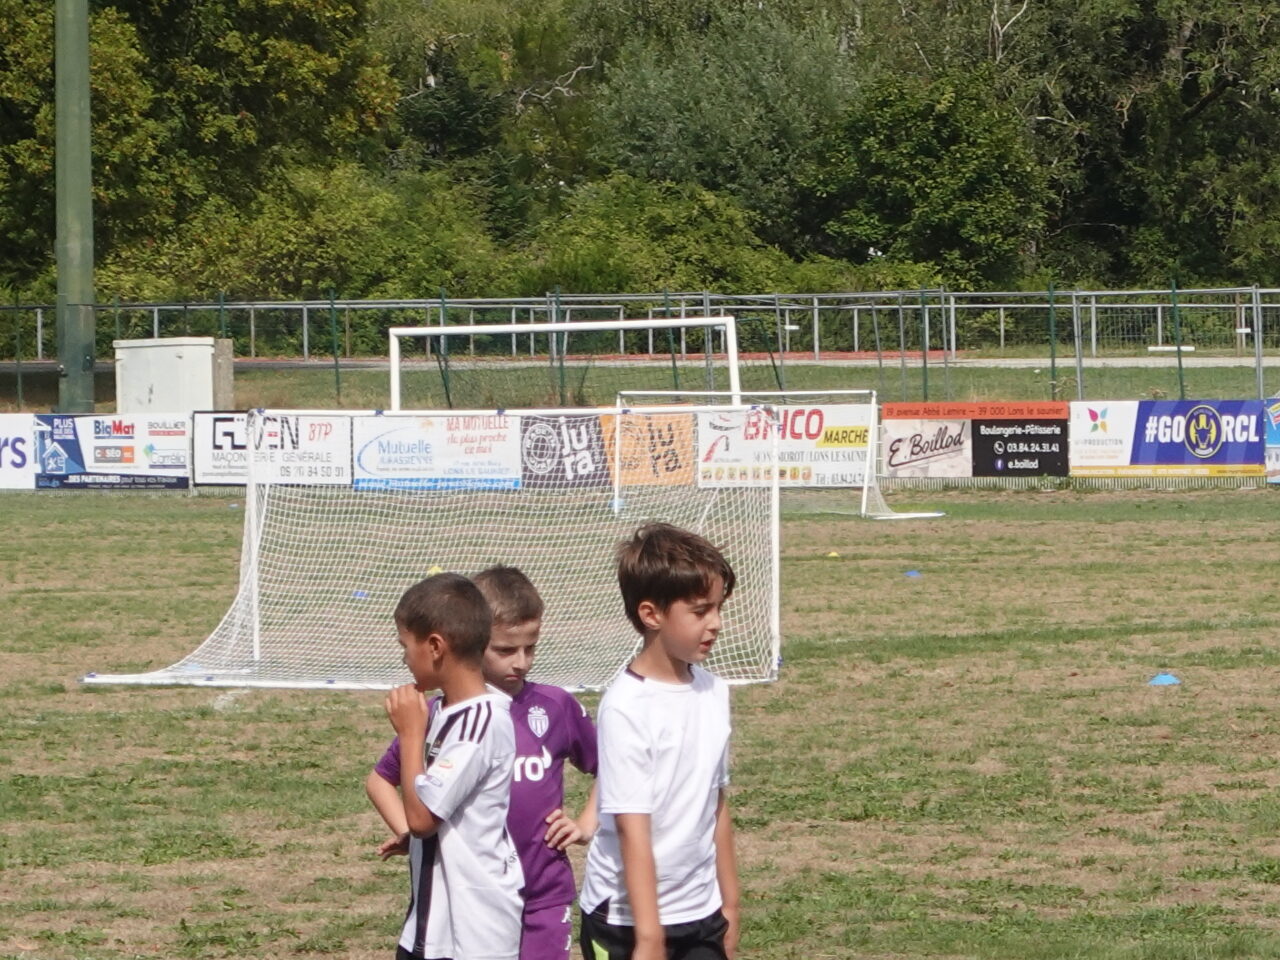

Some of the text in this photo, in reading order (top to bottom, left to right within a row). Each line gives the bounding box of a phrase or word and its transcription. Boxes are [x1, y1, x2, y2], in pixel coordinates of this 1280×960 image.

[897, 408, 920, 416] avenue
[978, 407, 987, 416] 39
[990, 407, 1005, 415] 000
[1007, 407, 1025, 415] Lons
[1027, 407, 1034, 415] le
[94, 420, 134, 436] BigMat
[1145, 415, 1185, 443] #GO
[1222, 415, 1260, 443] RCL
[910, 421, 965, 456] Boillod
[378, 440, 432, 455] Mutuelle
[212, 451, 276, 464] MAÇONERIE
